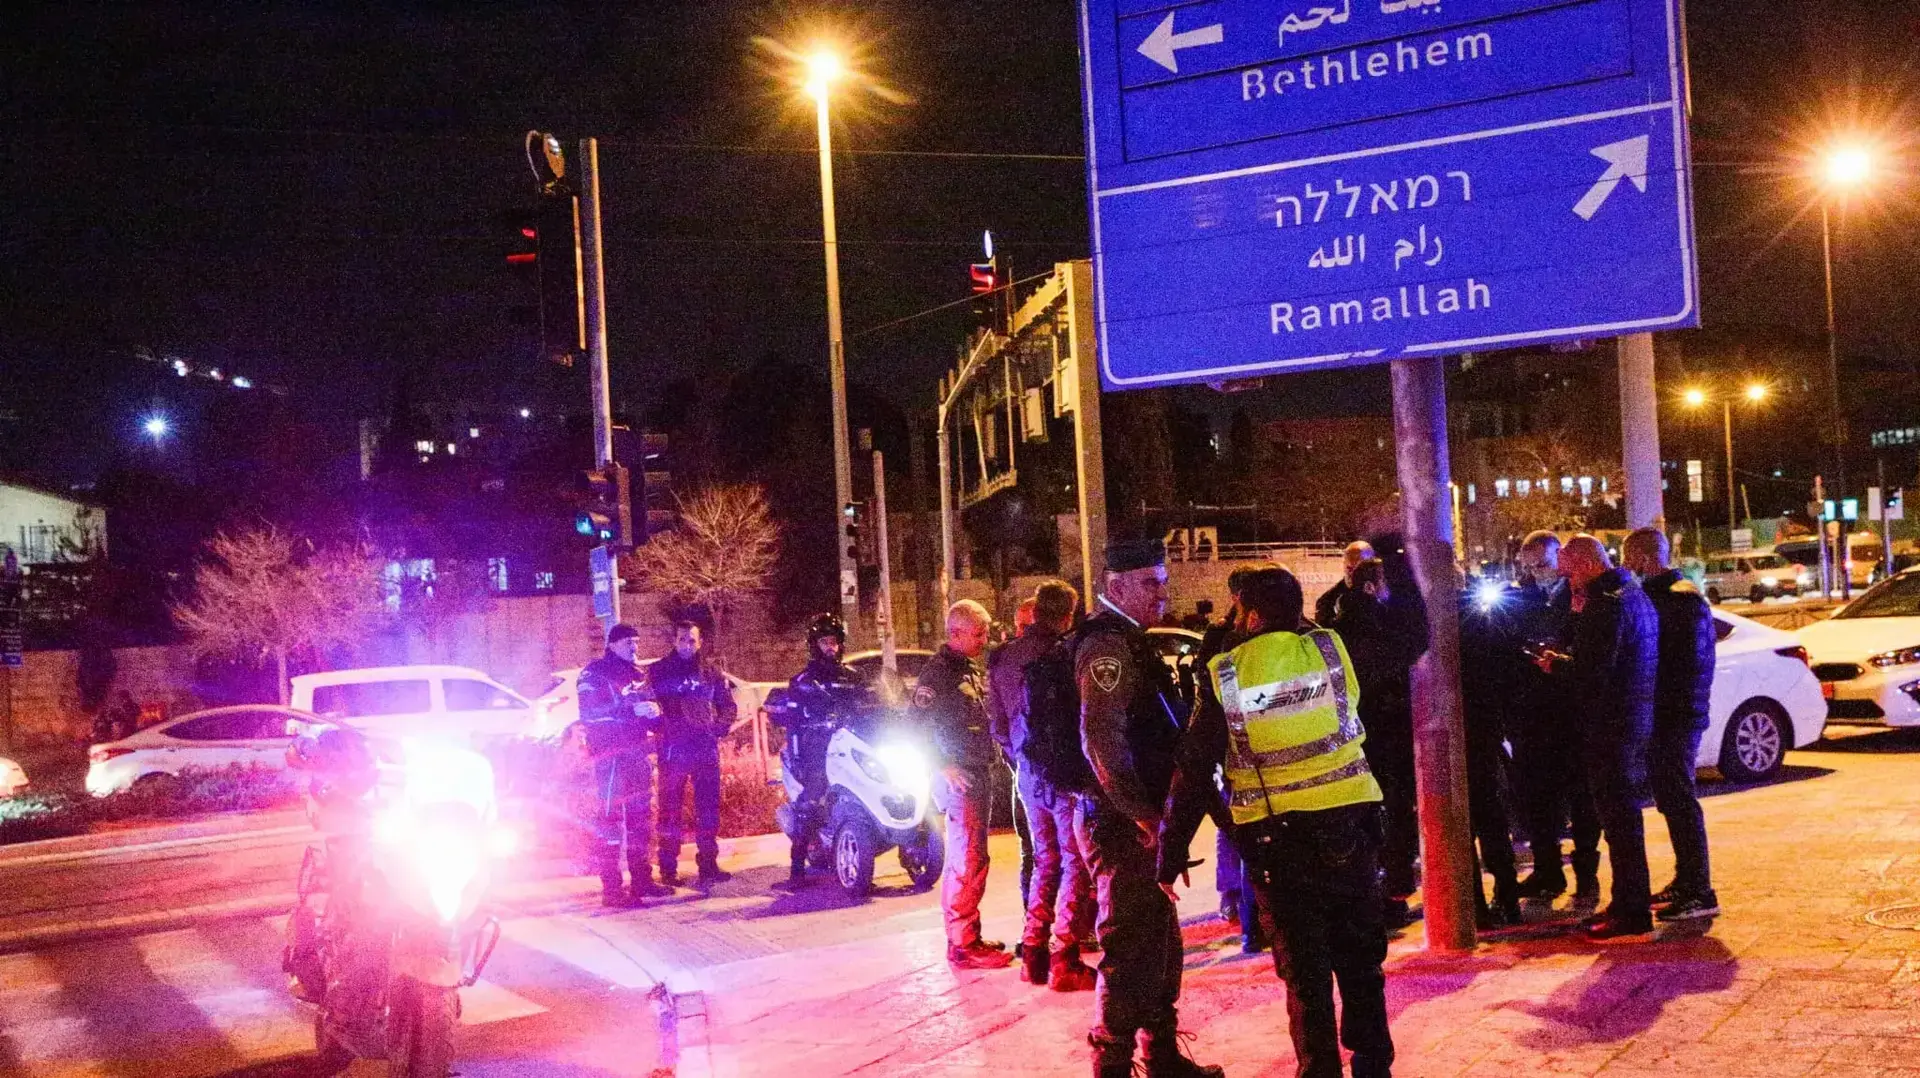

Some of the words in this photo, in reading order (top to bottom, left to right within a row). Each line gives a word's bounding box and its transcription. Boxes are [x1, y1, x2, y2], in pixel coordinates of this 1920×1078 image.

[1279, 0, 1350, 48] لحم
[1242, 31, 1492, 101] Bethlehem
[1275, 170, 1471, 228] רמאללה
[1307, 234, 1366, 269] الله
[1395, 224, 1443, 271] رام
[1270, 278, 1491, 335] Ramallah
